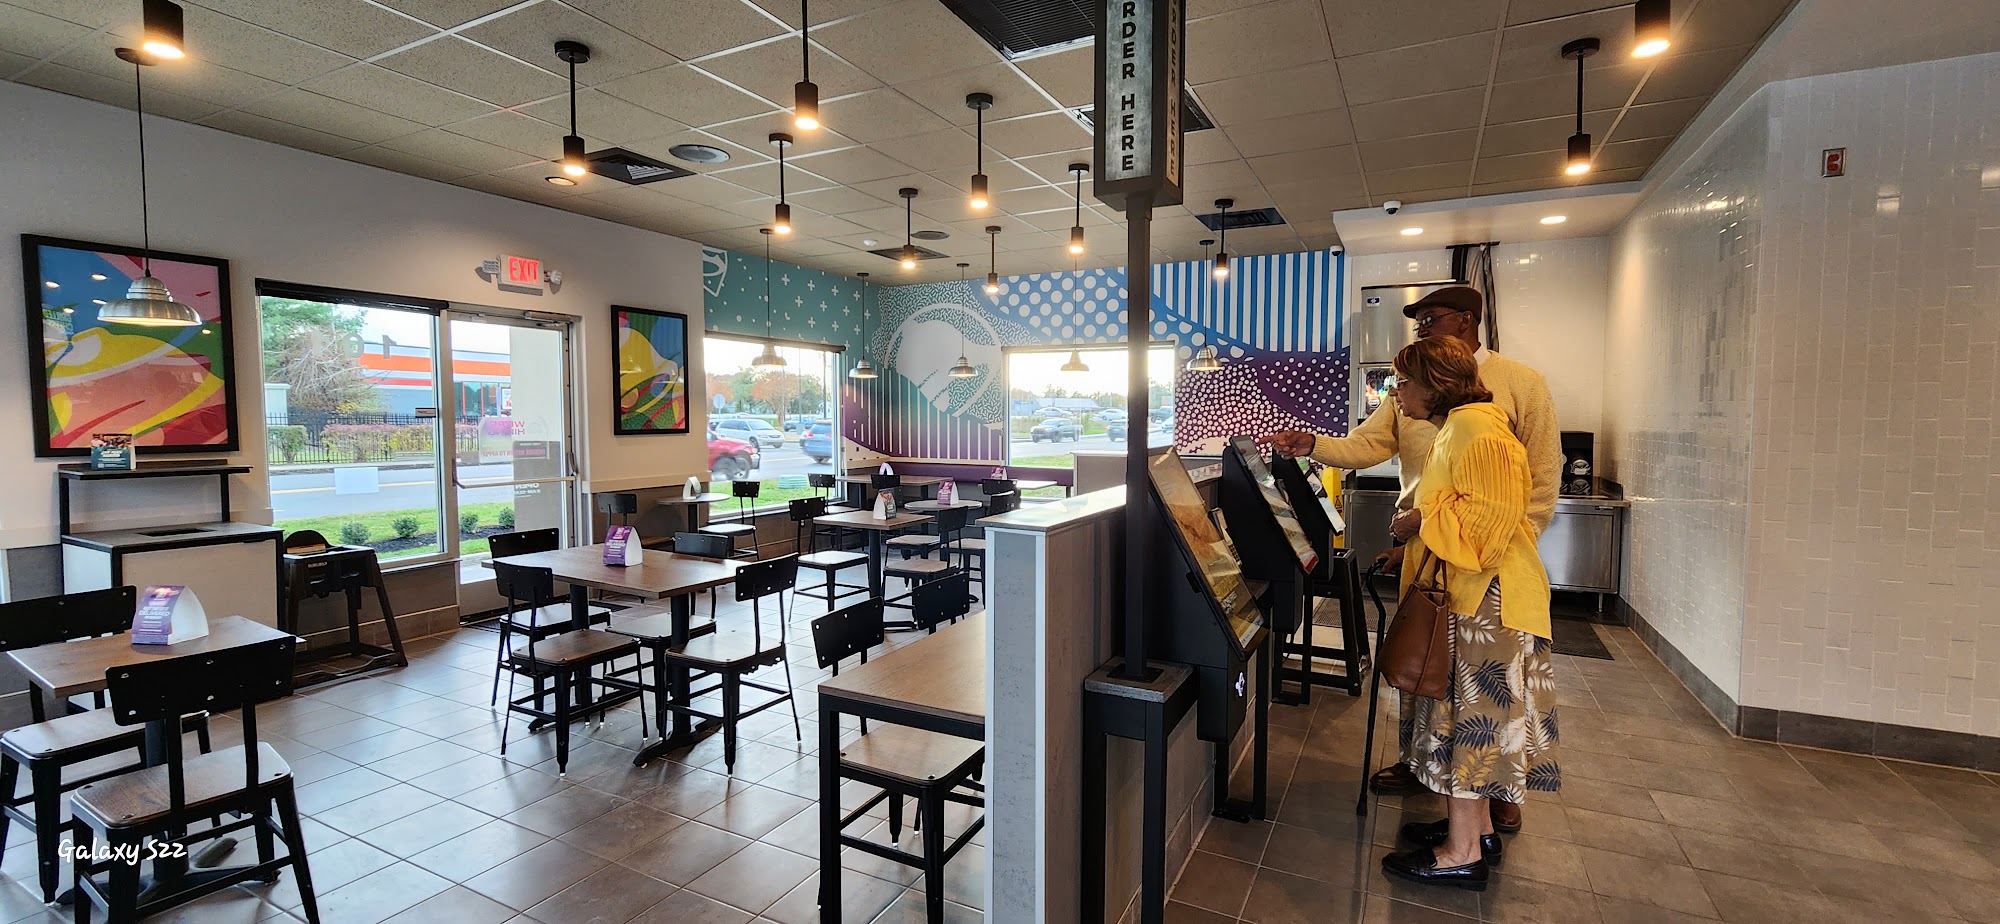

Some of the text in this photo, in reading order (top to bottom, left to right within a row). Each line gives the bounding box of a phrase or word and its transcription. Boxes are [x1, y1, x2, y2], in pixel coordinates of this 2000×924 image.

[1121, 0, 1136, 171] RDER HERE
[1170, 0, 1178, 176] RDER HERE
[508, 255, 539, 285] EXIT
